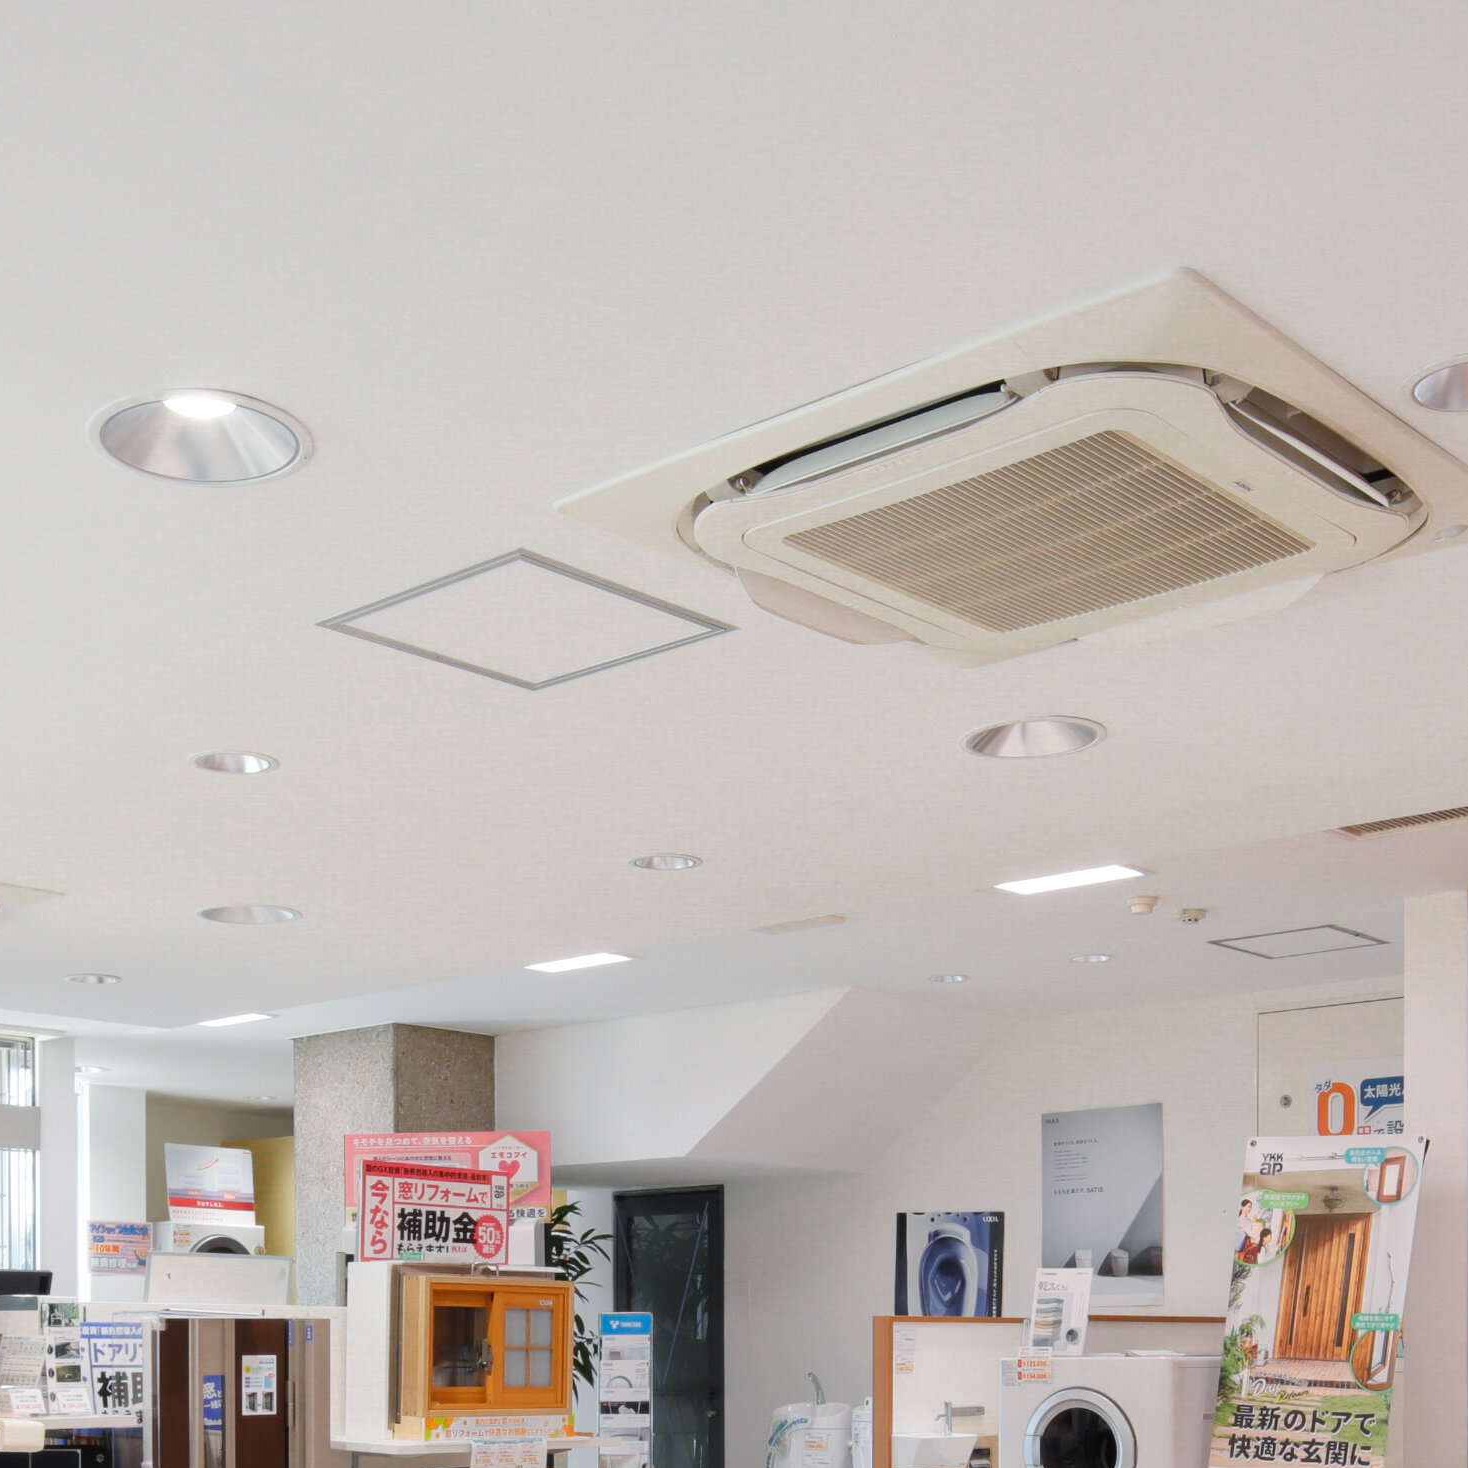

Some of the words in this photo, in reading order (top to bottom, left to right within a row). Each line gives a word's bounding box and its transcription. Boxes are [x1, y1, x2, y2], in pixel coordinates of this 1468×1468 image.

[1259, 1162, 1283, 1176] ap
[1262, 1153, 1283, 1163] YKK
[398, 1181, 488, 1204] 窓リフォームで
[369, 1180, 390, 1255] 今なら
[397, 1208, 479, 1245] 補助金
[1233, 1404, 1377, 1436] 最新のドアで
[1228, 1433, 1373, 1467] 快適な玄関に
